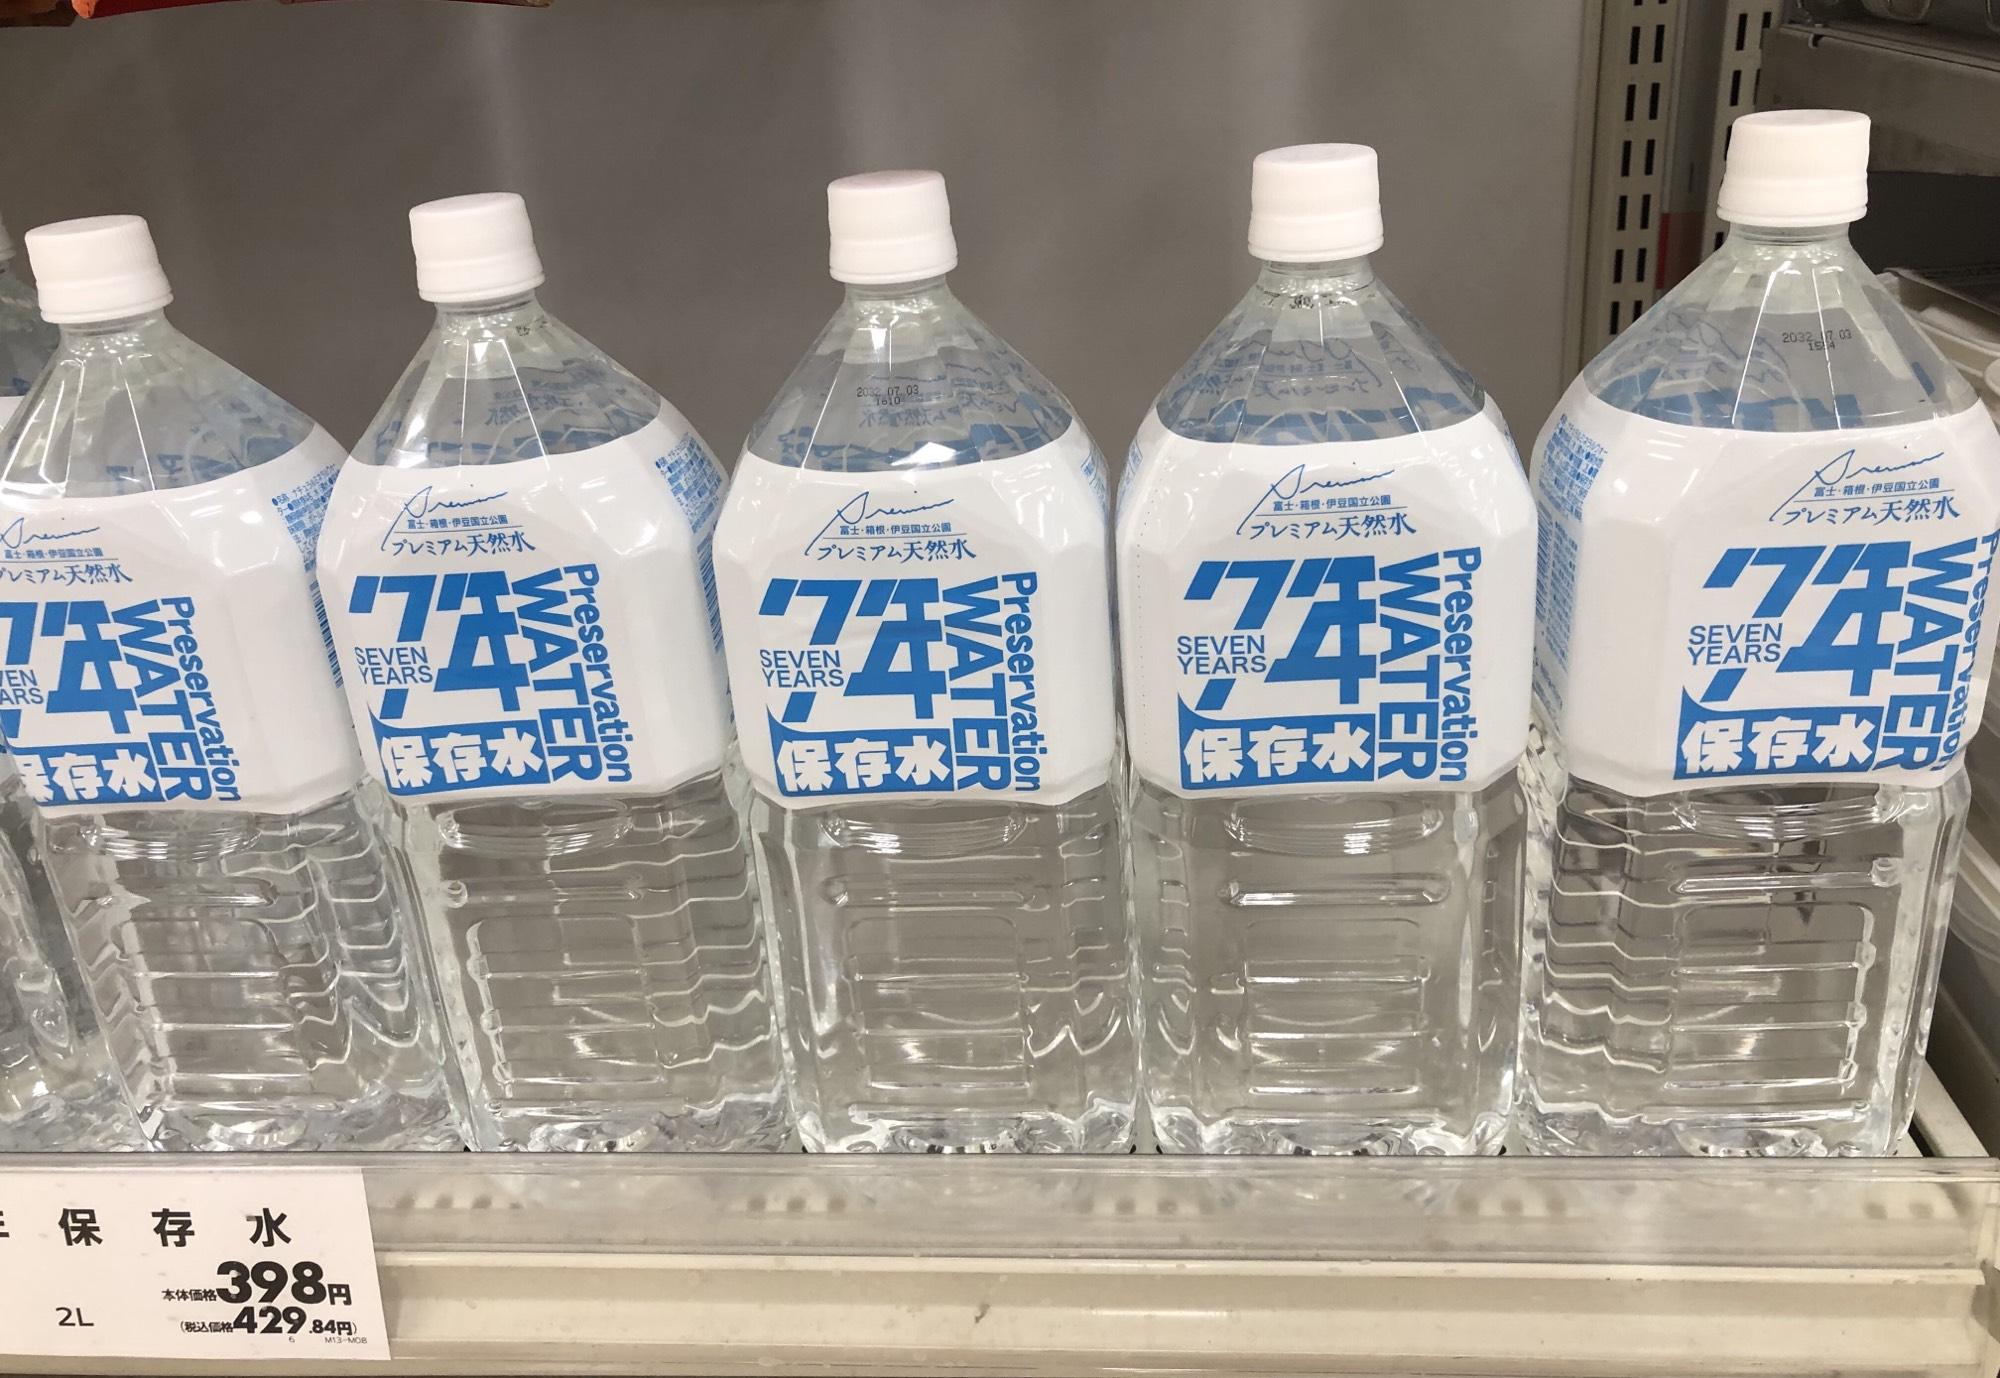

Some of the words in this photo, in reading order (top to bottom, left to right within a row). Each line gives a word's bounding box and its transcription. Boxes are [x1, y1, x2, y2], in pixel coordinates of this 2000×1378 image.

[1249, 512, 1417, 540] プレミアム天然水
[1782, 495, 1961, 526] プレミアム天然水
[392, 531, 535, 557] プレミアム天然水
[817, 538, 977, 563] プレミアム天然水
[1177, 634, 1266, 656] SEVEN
[1688, 623, 1783, 643] SEVEN
[1930, 528, 2000, 771] Preservation
[354, 646, 428, 666] SEVEN
[563, 563, 633, 782] Preservation
[760, 649, 841, 669] SEVEN
[1177, 655, 1267, 675] YEARS
[1378, 552, 1441, 780] WATER
[1440, 546, 1482, 782] Preservation
[1687, 643, 1782, 666] YEARS
[1872, 537, 1979, 772] WATER
[359, 665, 433, 685] YEARS
[511, 567, 603, 782] WATER
[761, 669, 844, 689] YEARS
[942, 575, 1011, 791] WATER
[1001, 571, 1048, 792] Preservation
[0, 687, 44, 705] ARS
[111, 599, 213, 802] WATER
[161, 596, 242, 801] Preservation
[381, 728, 544, 788] 保存水
[1184, 721, 1372, 784] 保存水
[1682, 713, 1875, 775] 保存水
[777, 736, 951, 792] 保存水
[0, 1208, 292, 1247] 保存水
[55, 1307, 94, 1327] 2L
